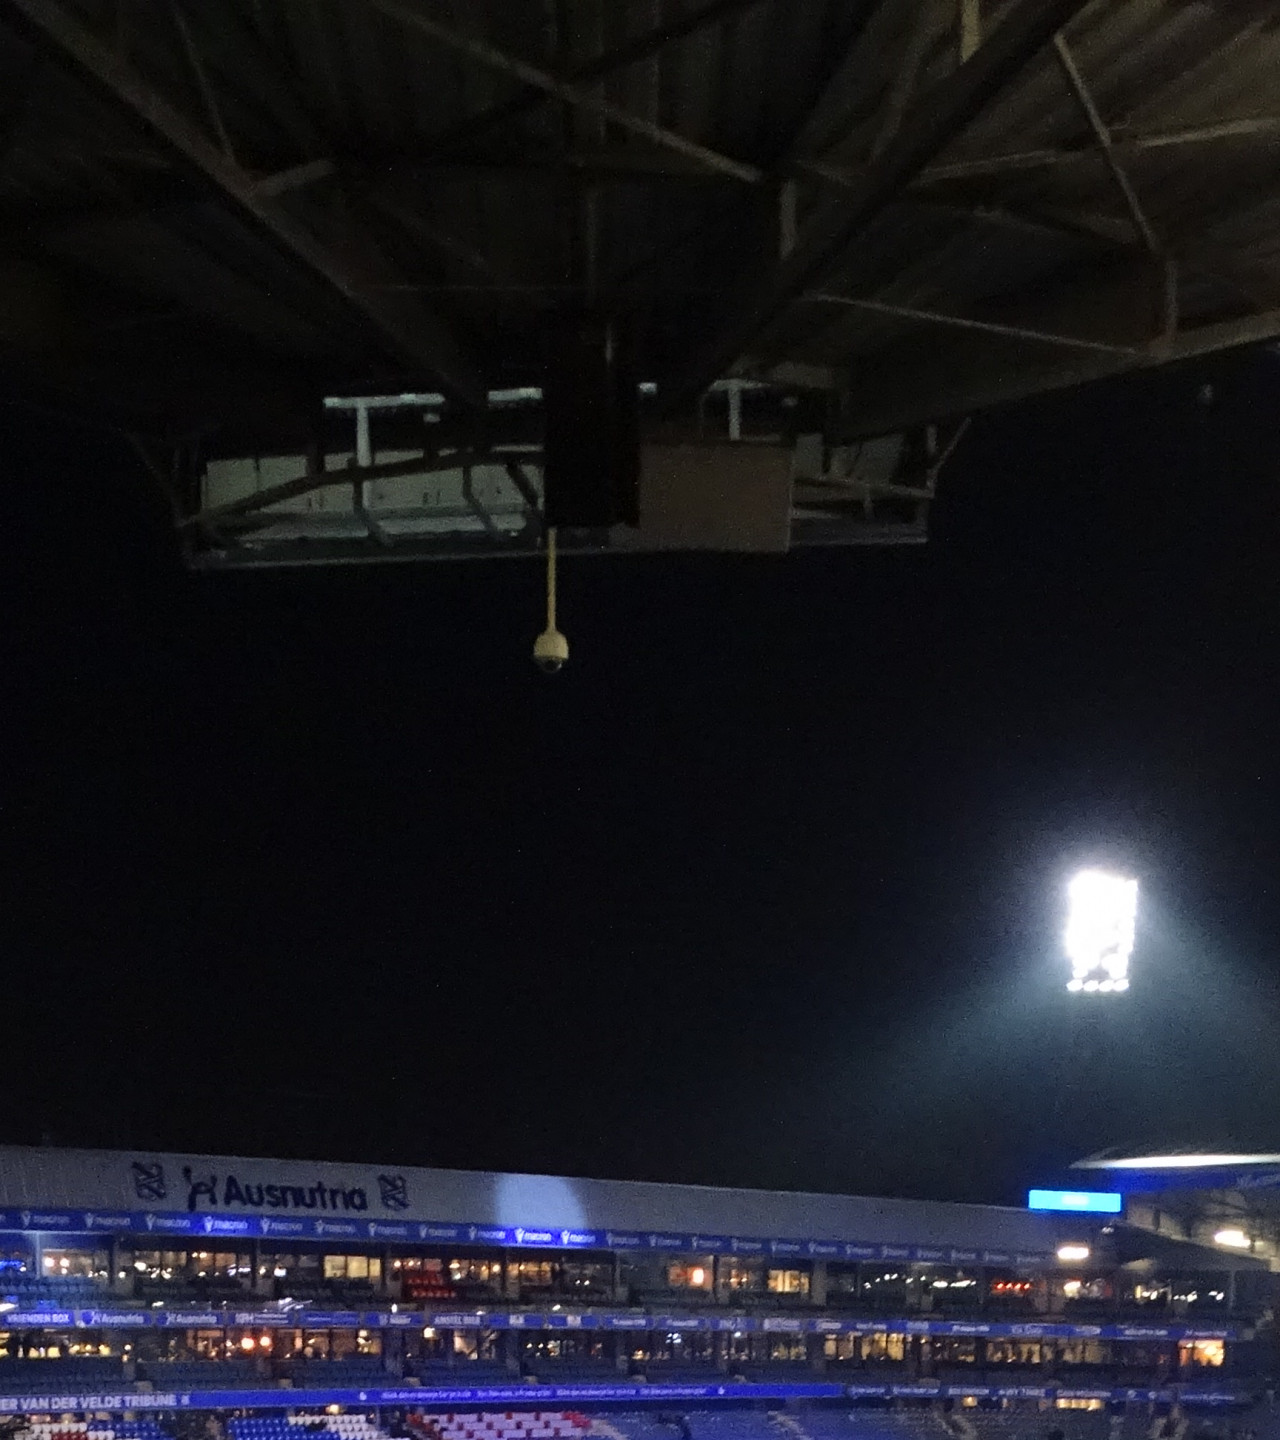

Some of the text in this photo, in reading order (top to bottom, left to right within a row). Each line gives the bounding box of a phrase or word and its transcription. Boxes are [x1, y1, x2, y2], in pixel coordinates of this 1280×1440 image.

[224, 1174, 369, 1212] Ausnutria
[6, 1312, 70, 1325] VRIENDEN BOX
[20, 1397, 48, 1411] VAN
[51, 1396, 77, 1409] DER
[80, 1395, 123, 1408] VELDE
[125, 1394, 177, 1407] TRIBUNE
